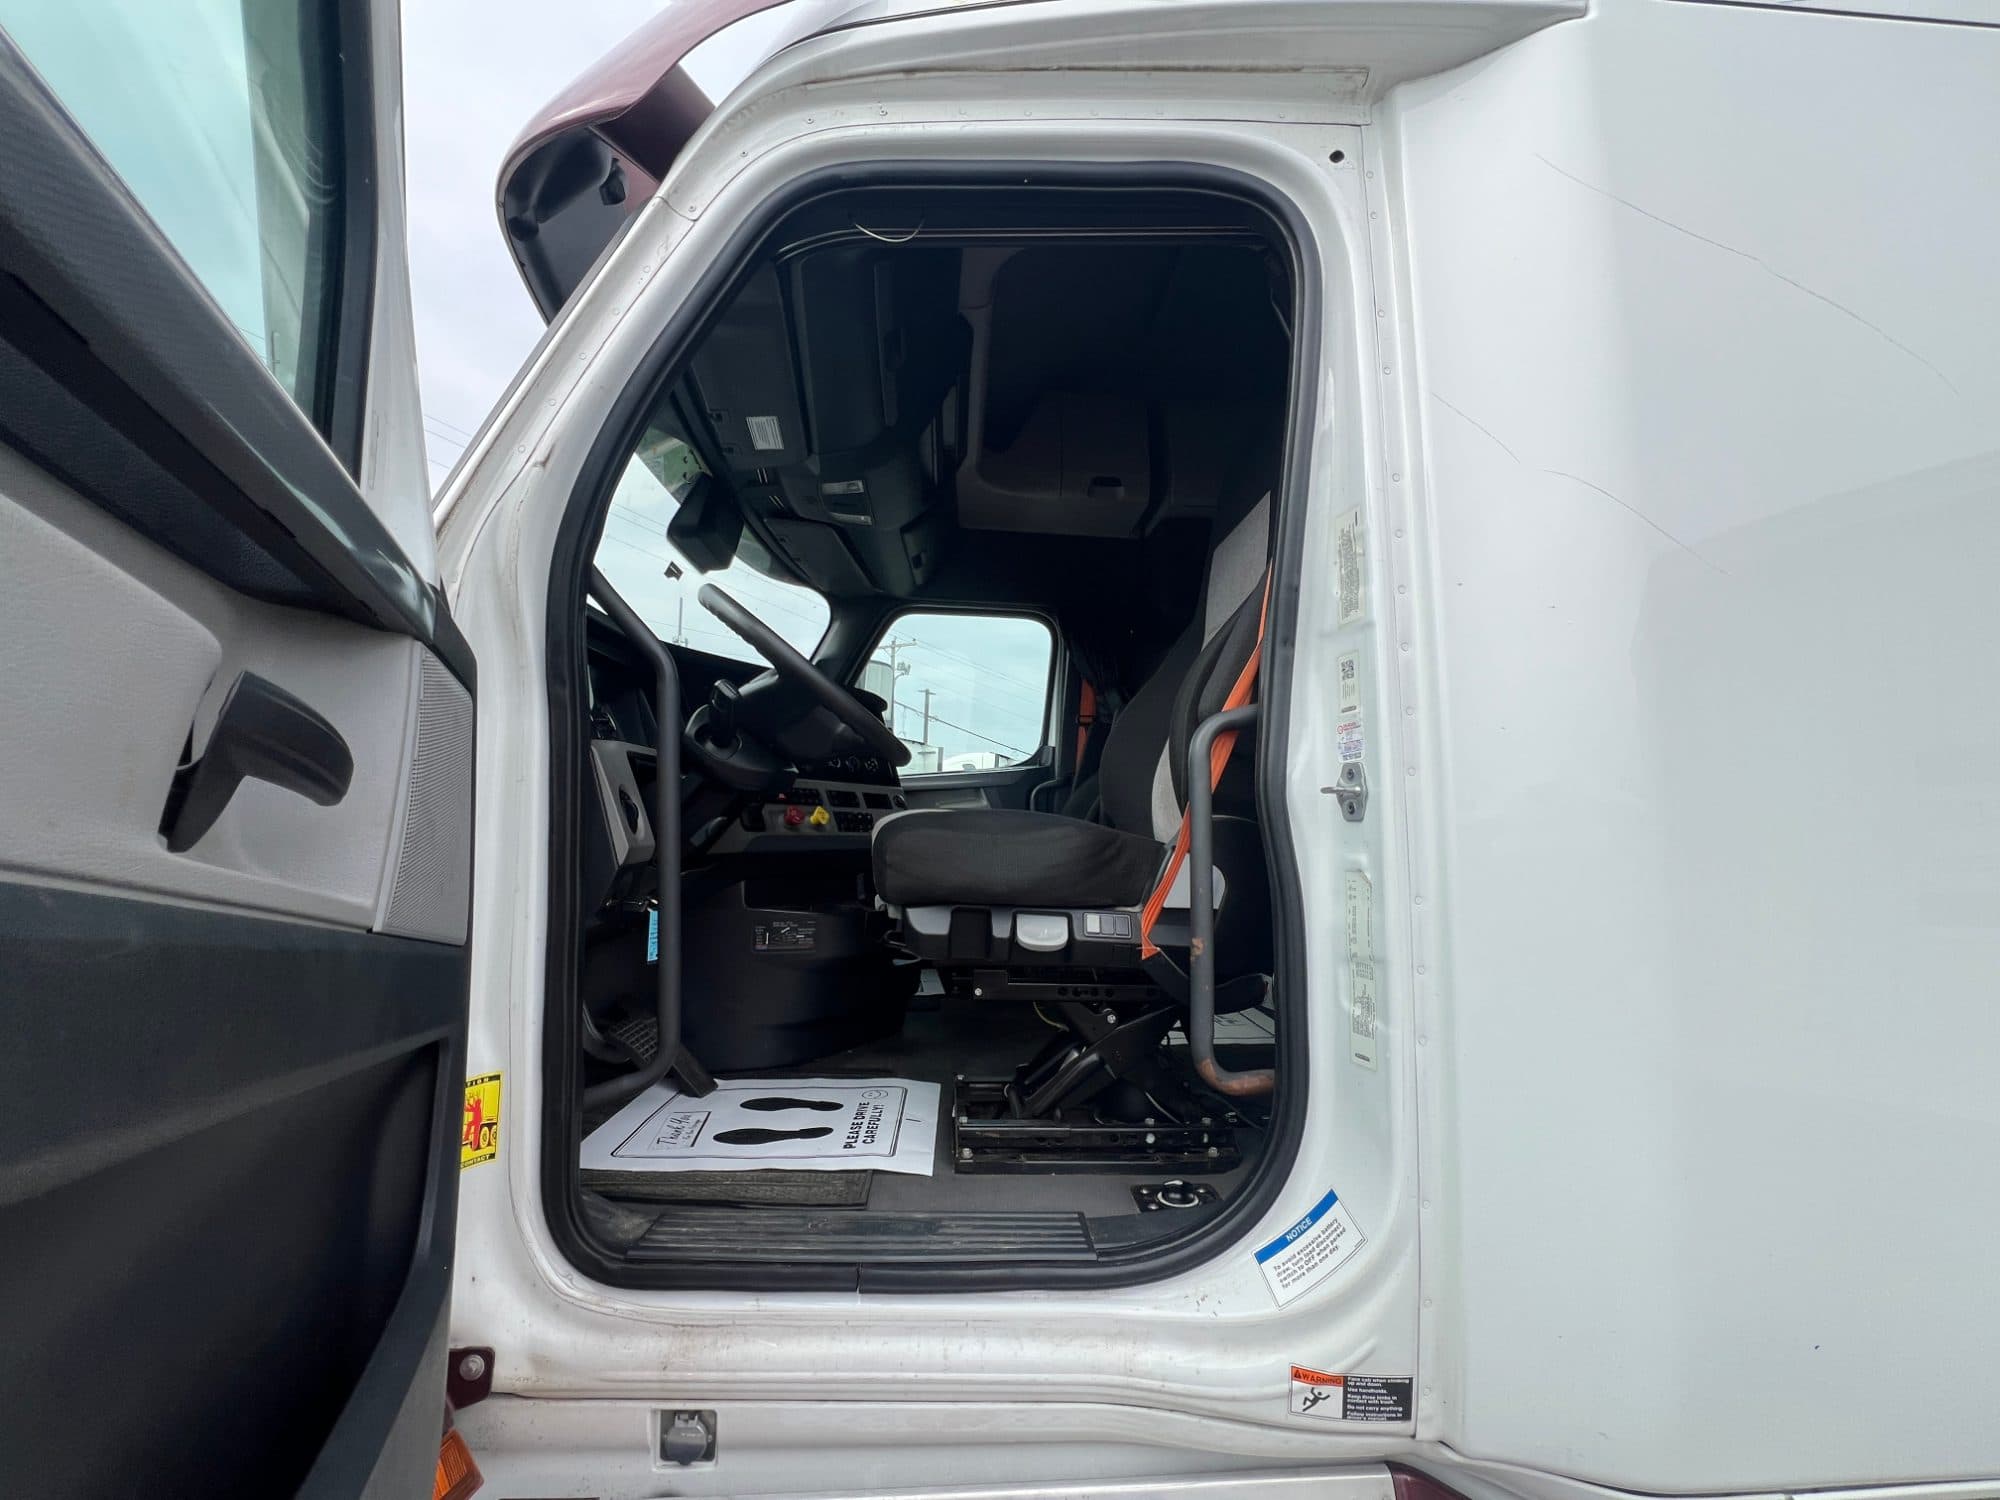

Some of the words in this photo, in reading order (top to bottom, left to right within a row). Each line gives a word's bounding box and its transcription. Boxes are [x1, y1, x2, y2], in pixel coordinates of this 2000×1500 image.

[843, 1122, 863, 1149] PLEASE
[853, 1102, 870, 1120] DRIVE
[862, 1104, 885, 1144] CAREFULLY!
[1281, 1253, 1296, 1266] avoid
[1297, 1234, 1320, 1255] excessive
[1321, 1218, 1338, 1234] battery
[1286, 1217, 1312, 1242] NOTICE
[1291, 1256, 1303, 1267] turn
[1315, 1222, 1341, 1248] disconnect
[1279, 1268, 1297, 1282] switch
[1303, 1254, 1315, 1265] OFF
[1316, 1243, 1329, 1256] when
[1329, 1227, 1345, 1245] parked
[1291, 1272, 1305, 1283] more
[1306, 1262, 1318, 1272] than
[1318, 1253, 1328, 1263] one
[1302, 1373, 1342, 1384] WARNING
